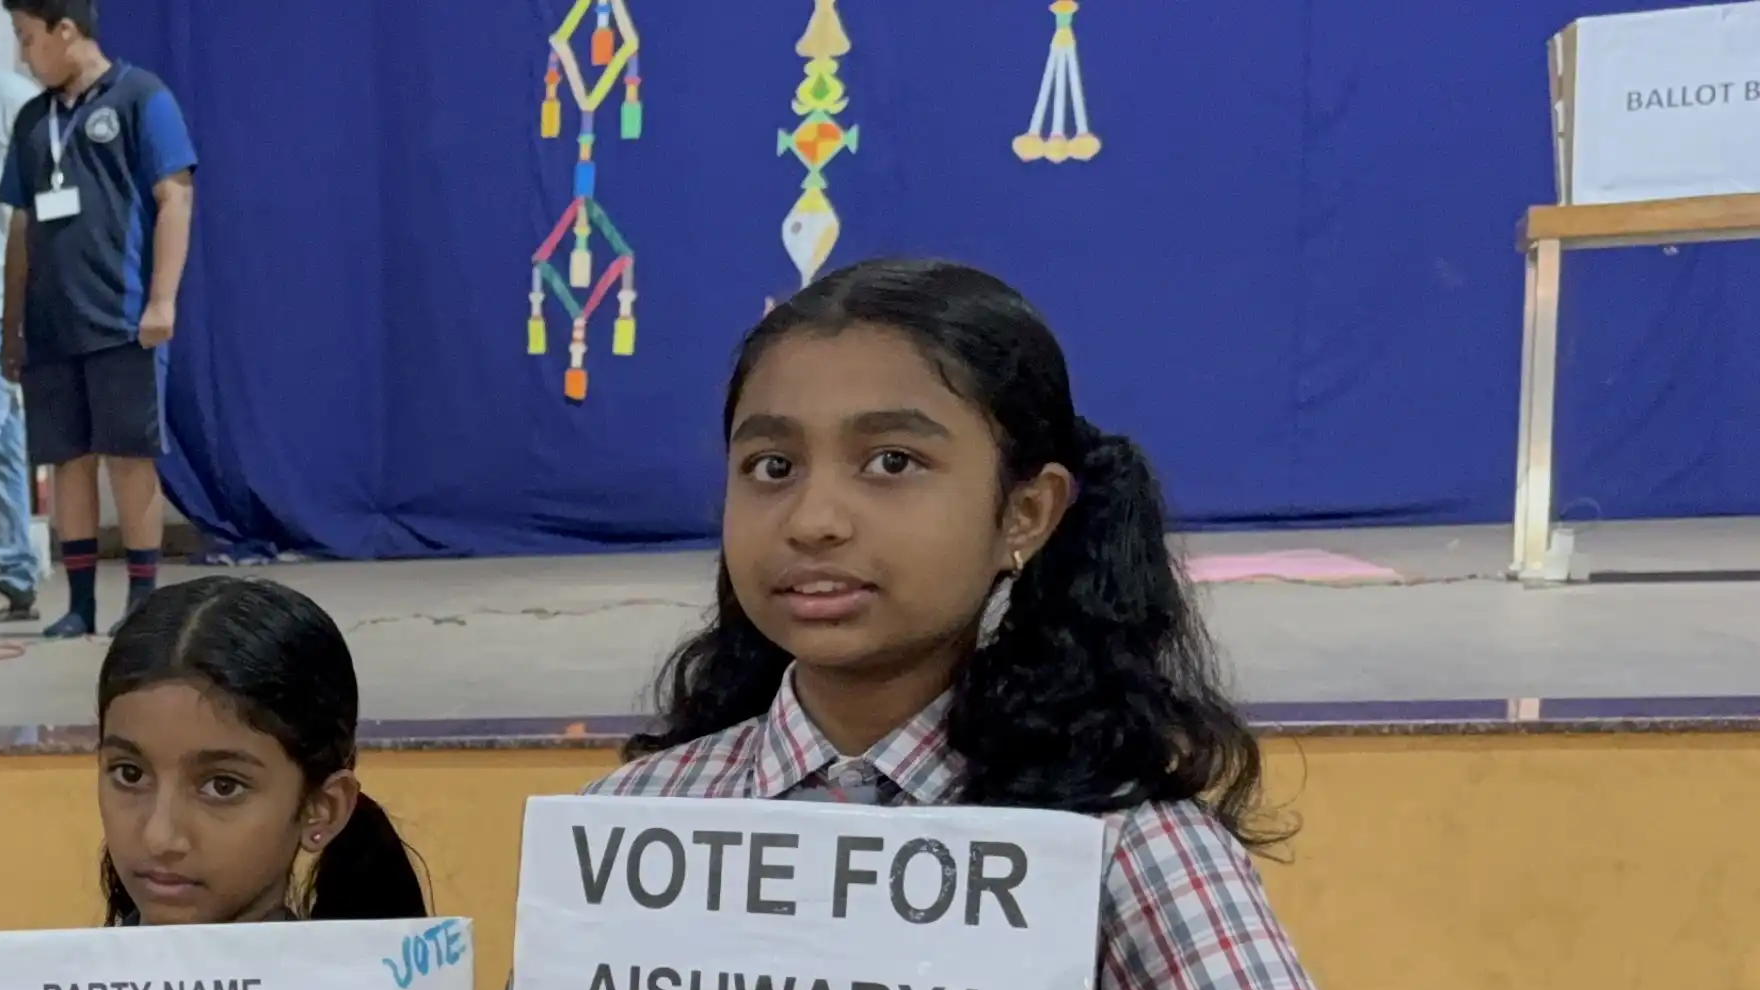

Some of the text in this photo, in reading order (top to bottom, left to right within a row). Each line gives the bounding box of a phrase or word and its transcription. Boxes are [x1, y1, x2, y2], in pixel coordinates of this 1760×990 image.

[1626, 82, 1735, 111] BALLOT
[571, 825, 1029, 929] VOTE FOR
[382, 918, 467, 989] VOTE
